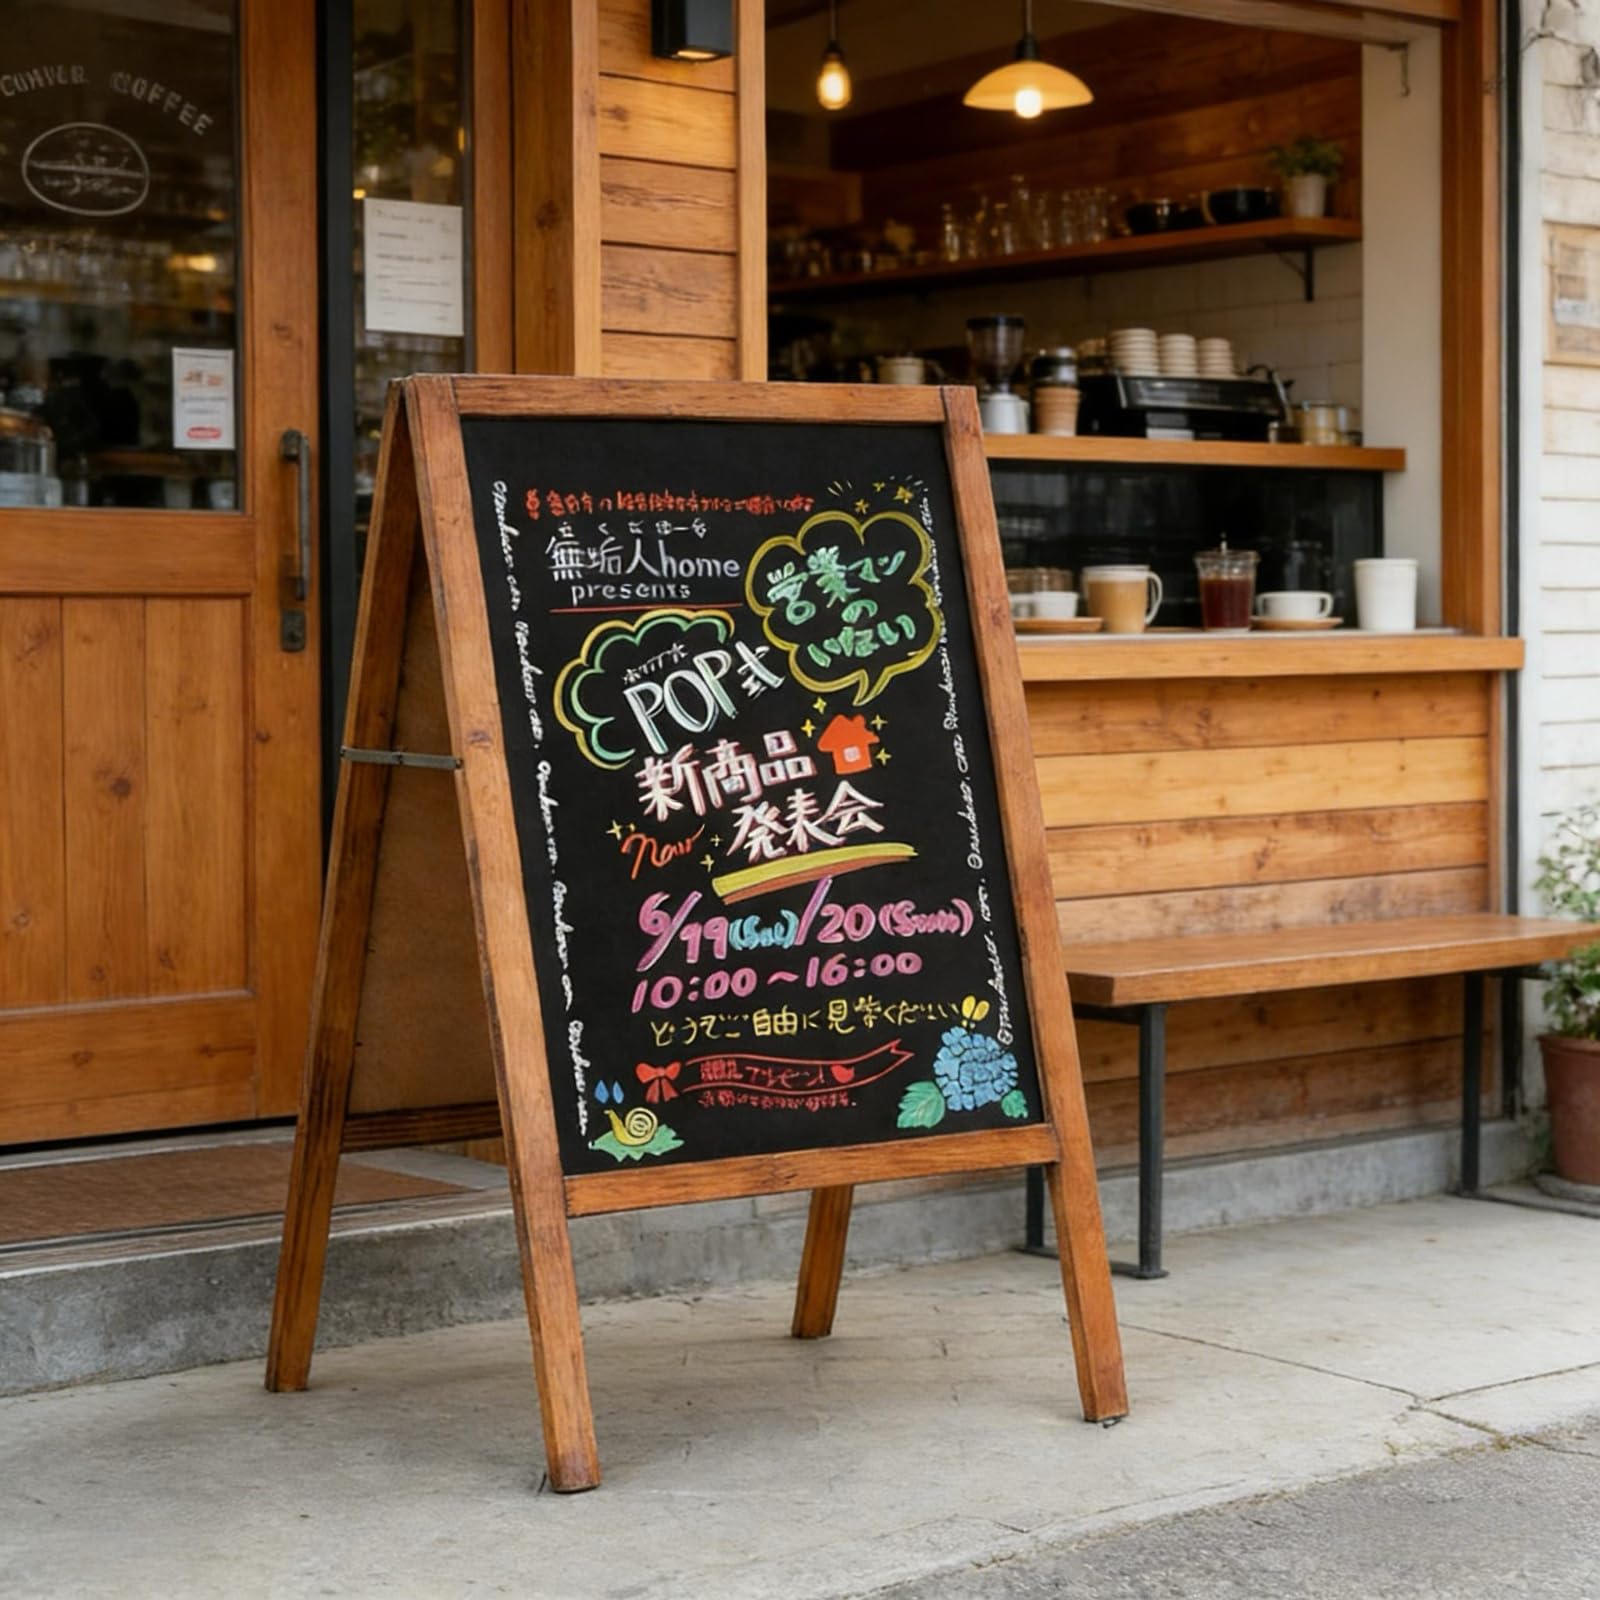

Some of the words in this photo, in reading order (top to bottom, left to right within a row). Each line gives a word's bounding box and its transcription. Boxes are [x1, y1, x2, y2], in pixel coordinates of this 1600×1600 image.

[109, 71, 214, 136] COFFEE
[726, 780, 884, 863] 発表会
